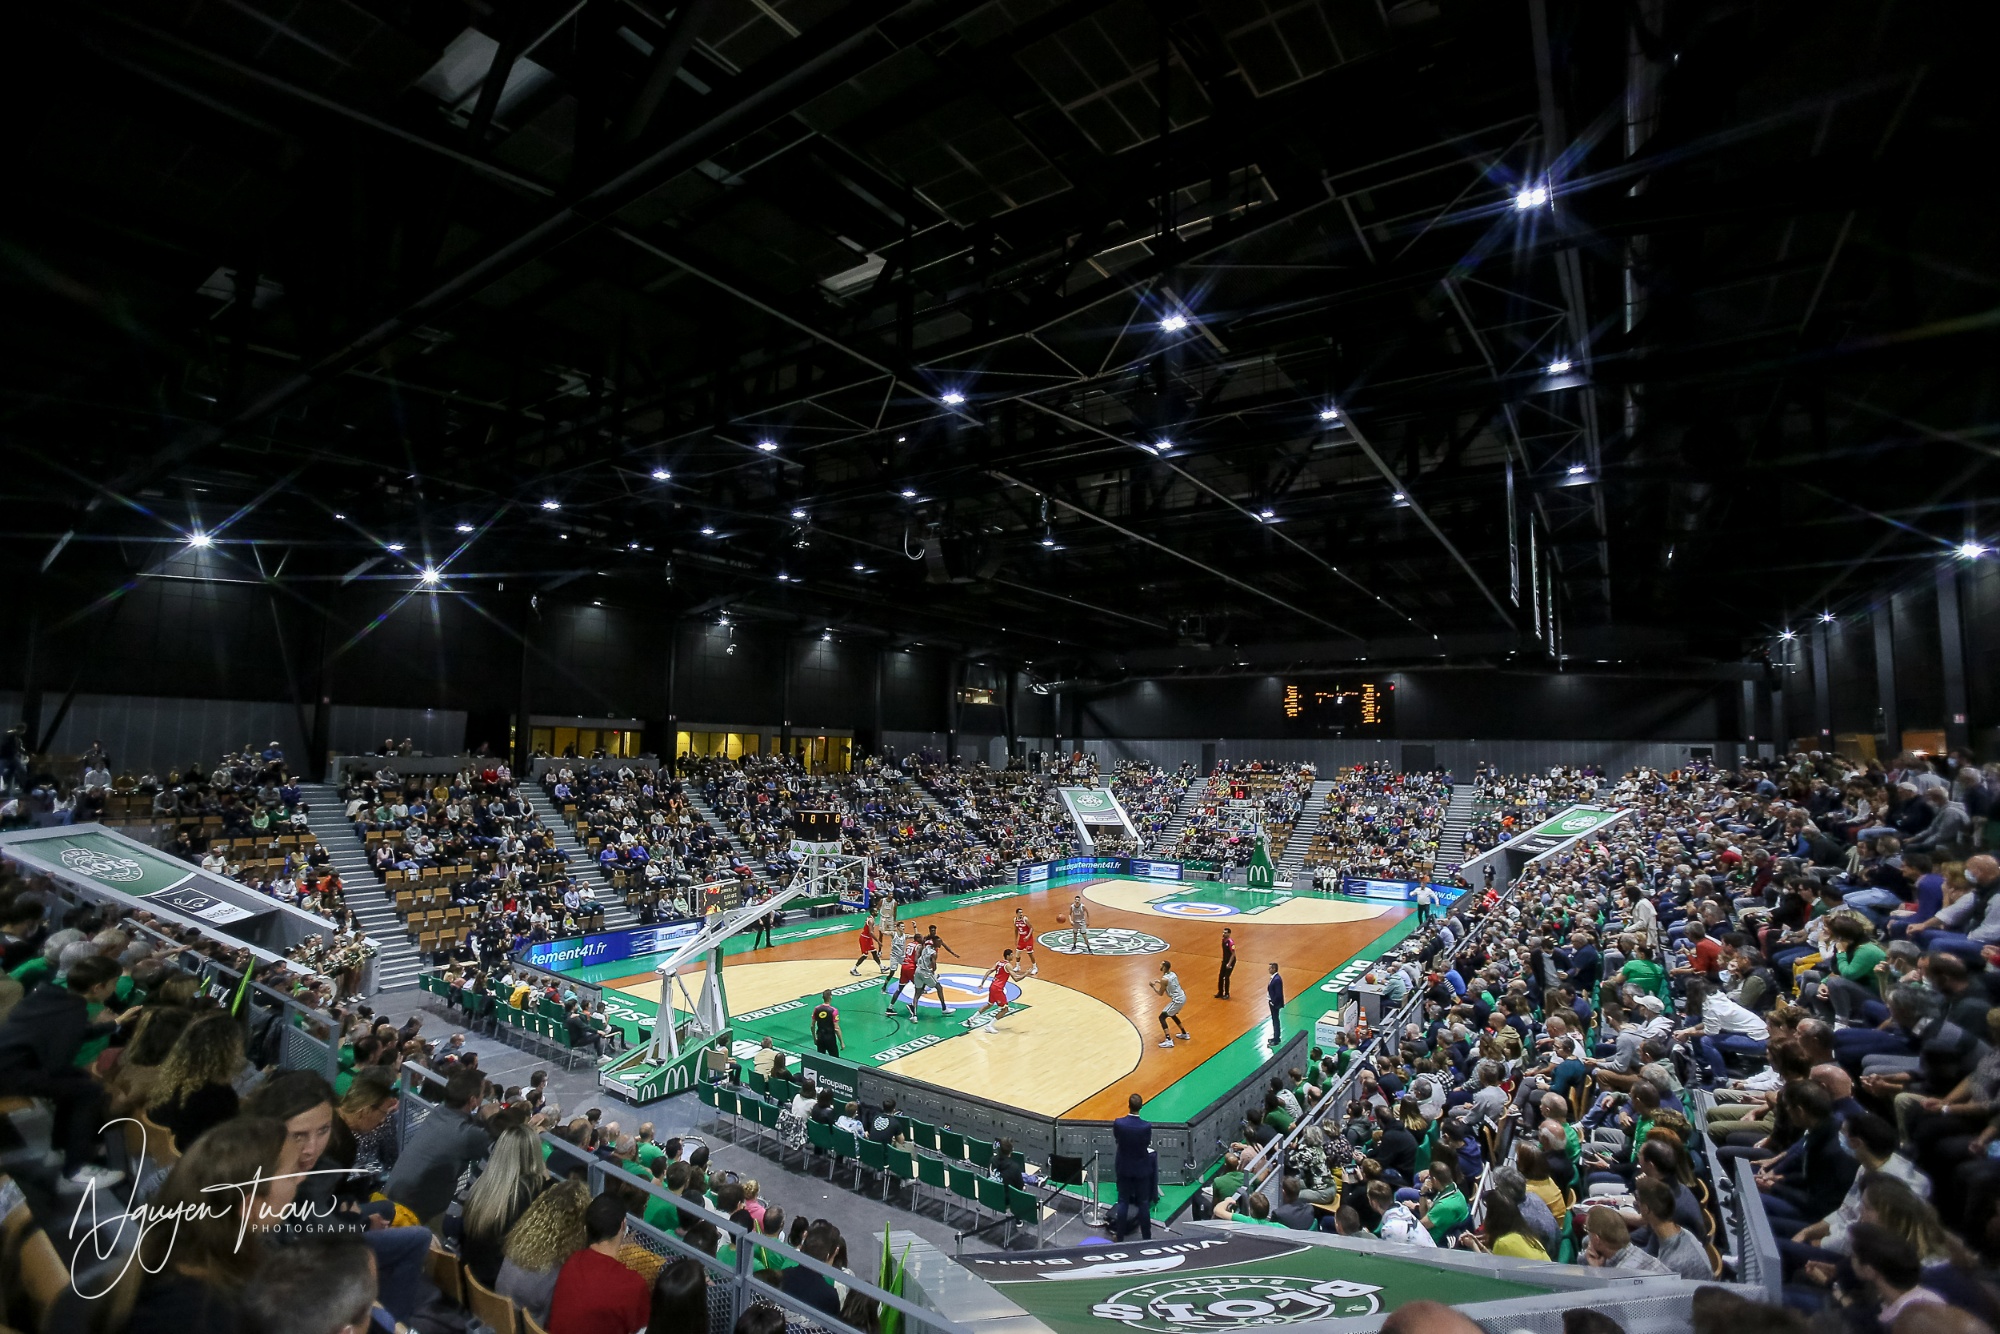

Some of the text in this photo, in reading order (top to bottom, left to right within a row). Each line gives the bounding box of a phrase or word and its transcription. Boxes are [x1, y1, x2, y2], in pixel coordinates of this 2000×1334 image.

[530, 942, 607, 965] tement41.fr
[1320, 959, 1373, 993] BLOIS
[735, 1000, 807, 1023] SIDAMO
[872, 1034, 943, 1061] SIDAMO
[819, 1075, 853, 1093] Groupama
[1082, 1252, 1129, 1262] de
[1140, 1239, 1229, 1255] Ville
[1132, 1278, 1287, 1297] BASKET 41
[1092, 1279, 1384, 1321] BLOIS
